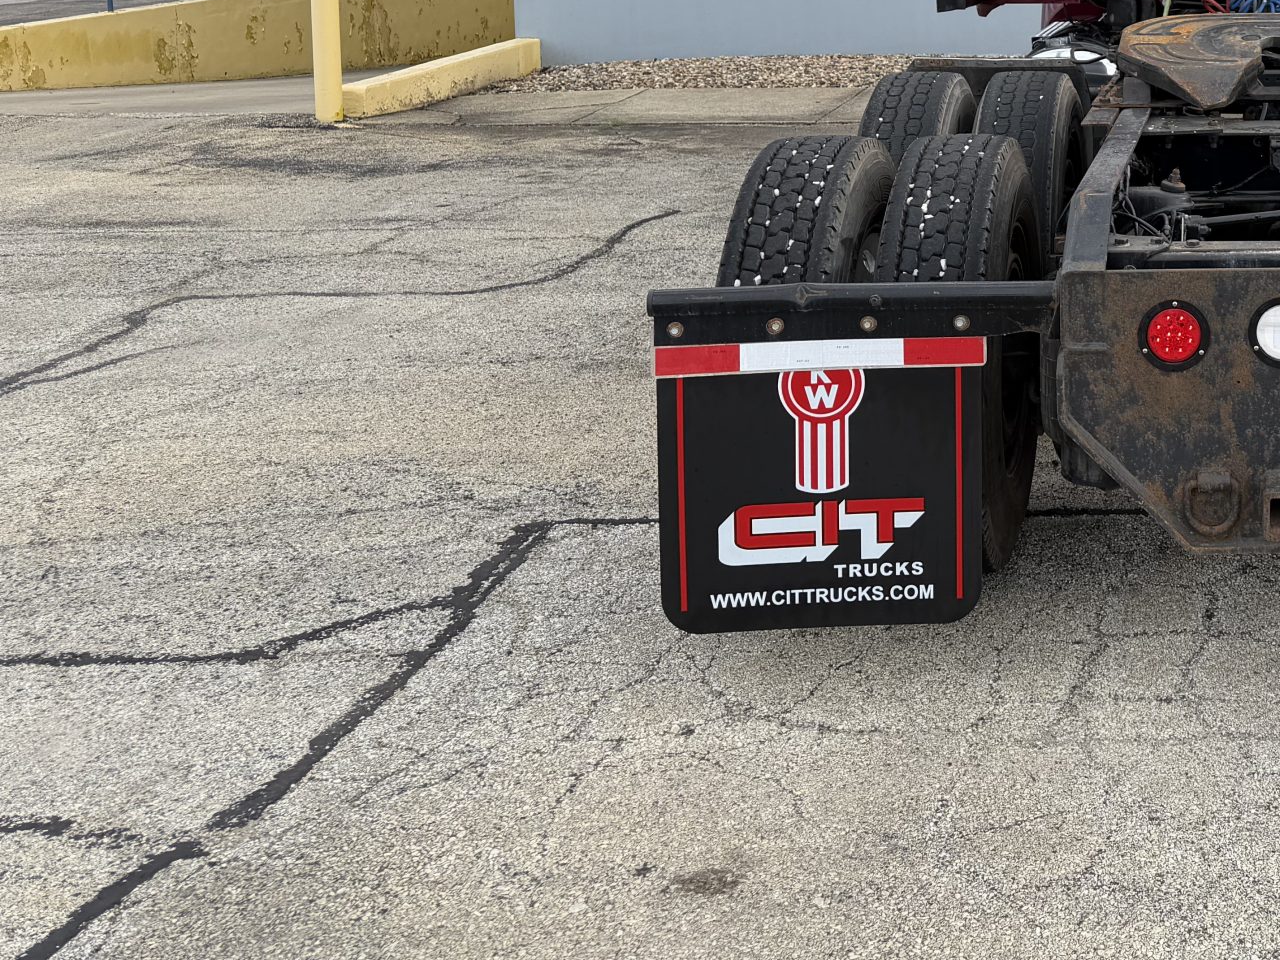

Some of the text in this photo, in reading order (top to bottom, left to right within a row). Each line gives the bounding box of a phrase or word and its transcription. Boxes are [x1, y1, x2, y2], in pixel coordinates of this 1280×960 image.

[803, 384, 840, 409] W
[718, 497, 926, 566] CIT
[833, 561, 924, 578] TRUCKS
[710, 584, 935, 609] WWW.CITTRUCKS.COM
